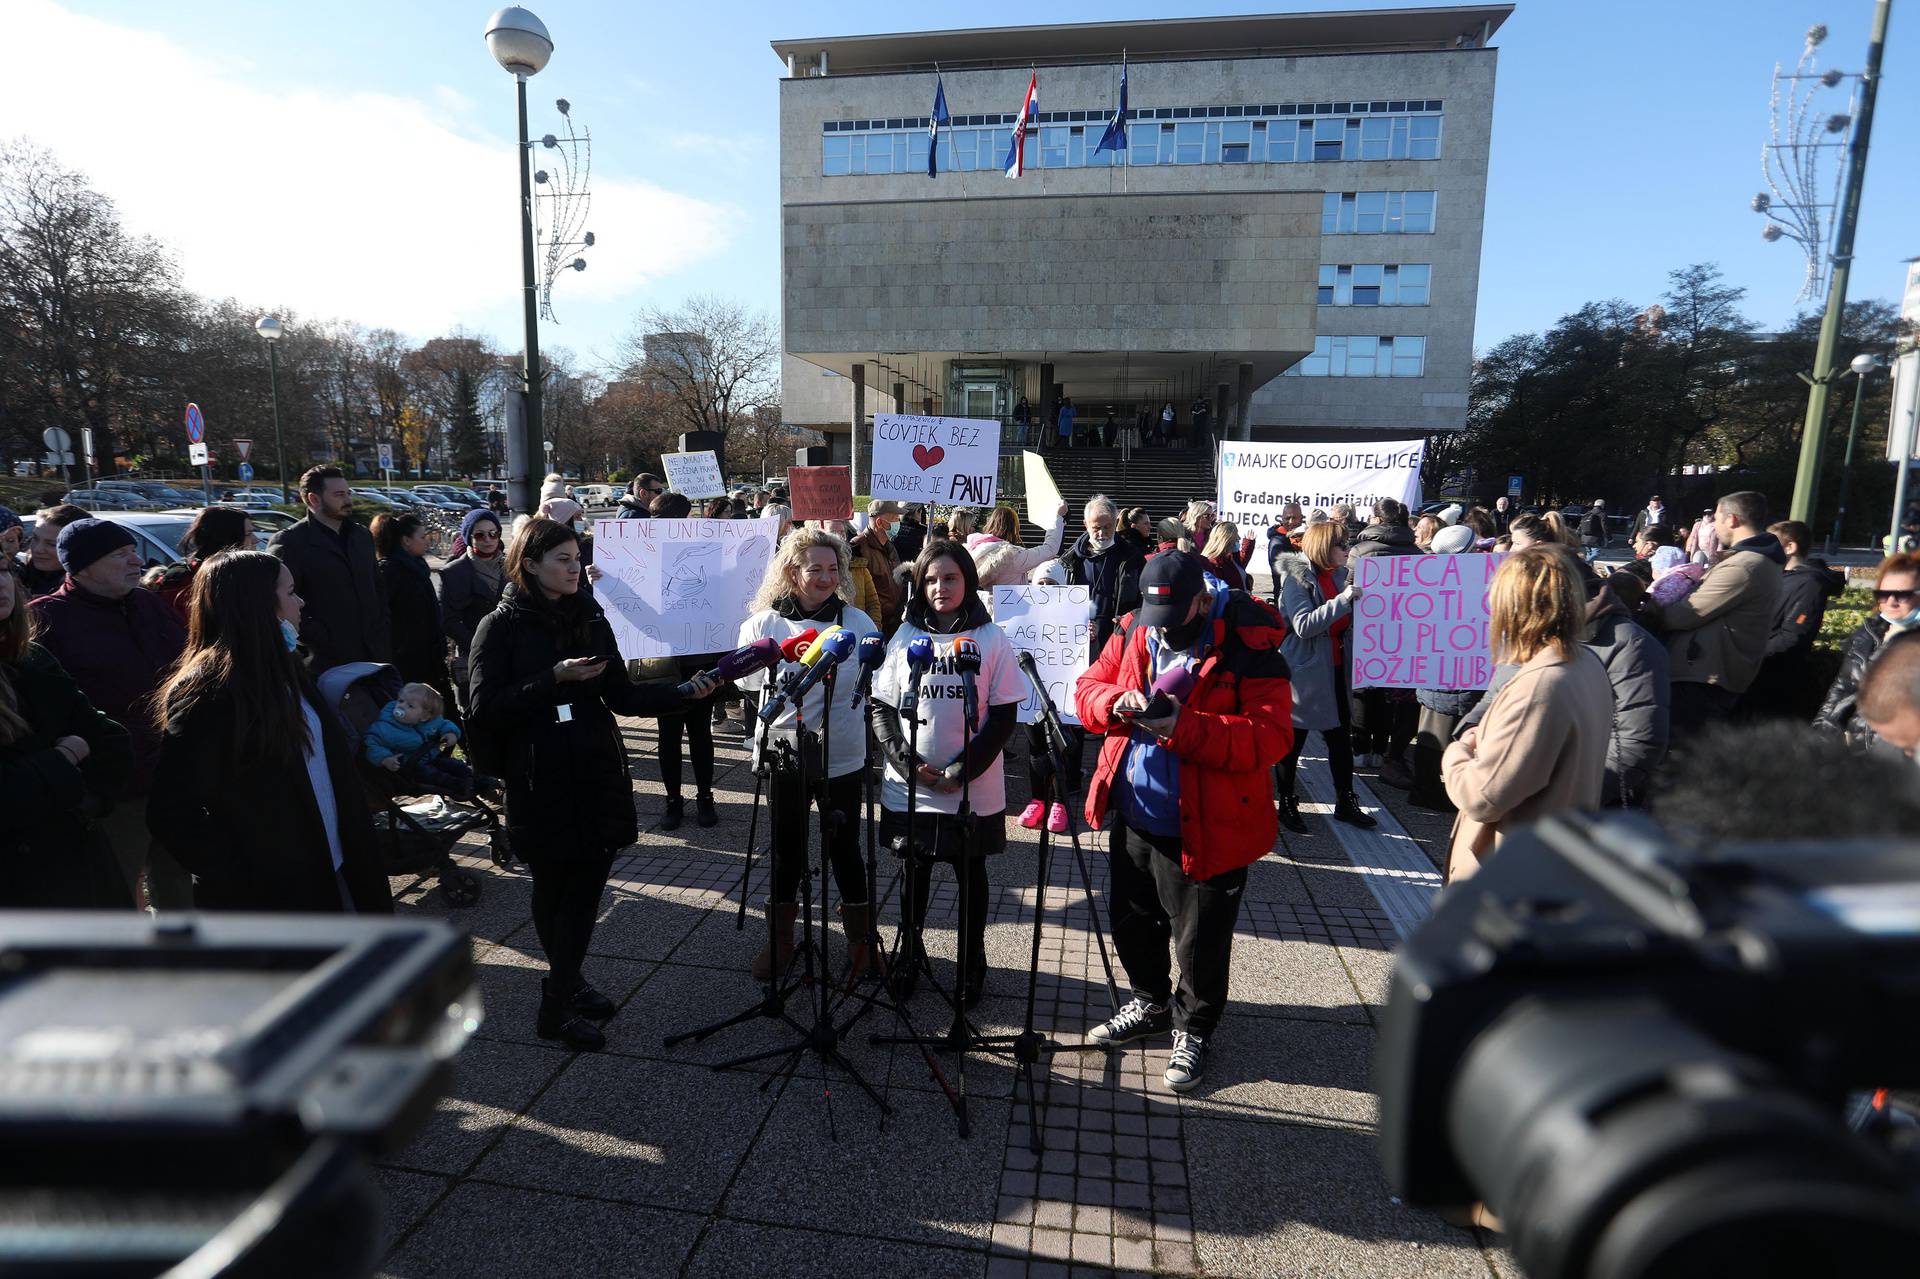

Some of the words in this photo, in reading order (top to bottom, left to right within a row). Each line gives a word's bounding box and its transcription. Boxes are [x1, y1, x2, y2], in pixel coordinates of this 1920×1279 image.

[879, 419, 938, 444] ČOVJEK
[948, 426, 980, 447] BEZ
[1238, 453, 1288, 469] MAJKE
[1291, 452, 1419, 469] ODGOJITELJICE
[929, 476, 944, 494] JE
[949, 473, 993, 506] PANJ
[1233, 490, 1311, 506] Građanska
[638, 522, 656, 540] NE
[1362, 555, 1462, 589] DJECA
[664, 598, 712, 611] SESTRA
[1362, 623, 1403, 655] SU
[1354, 654, 1429, 686] BOŽJE
